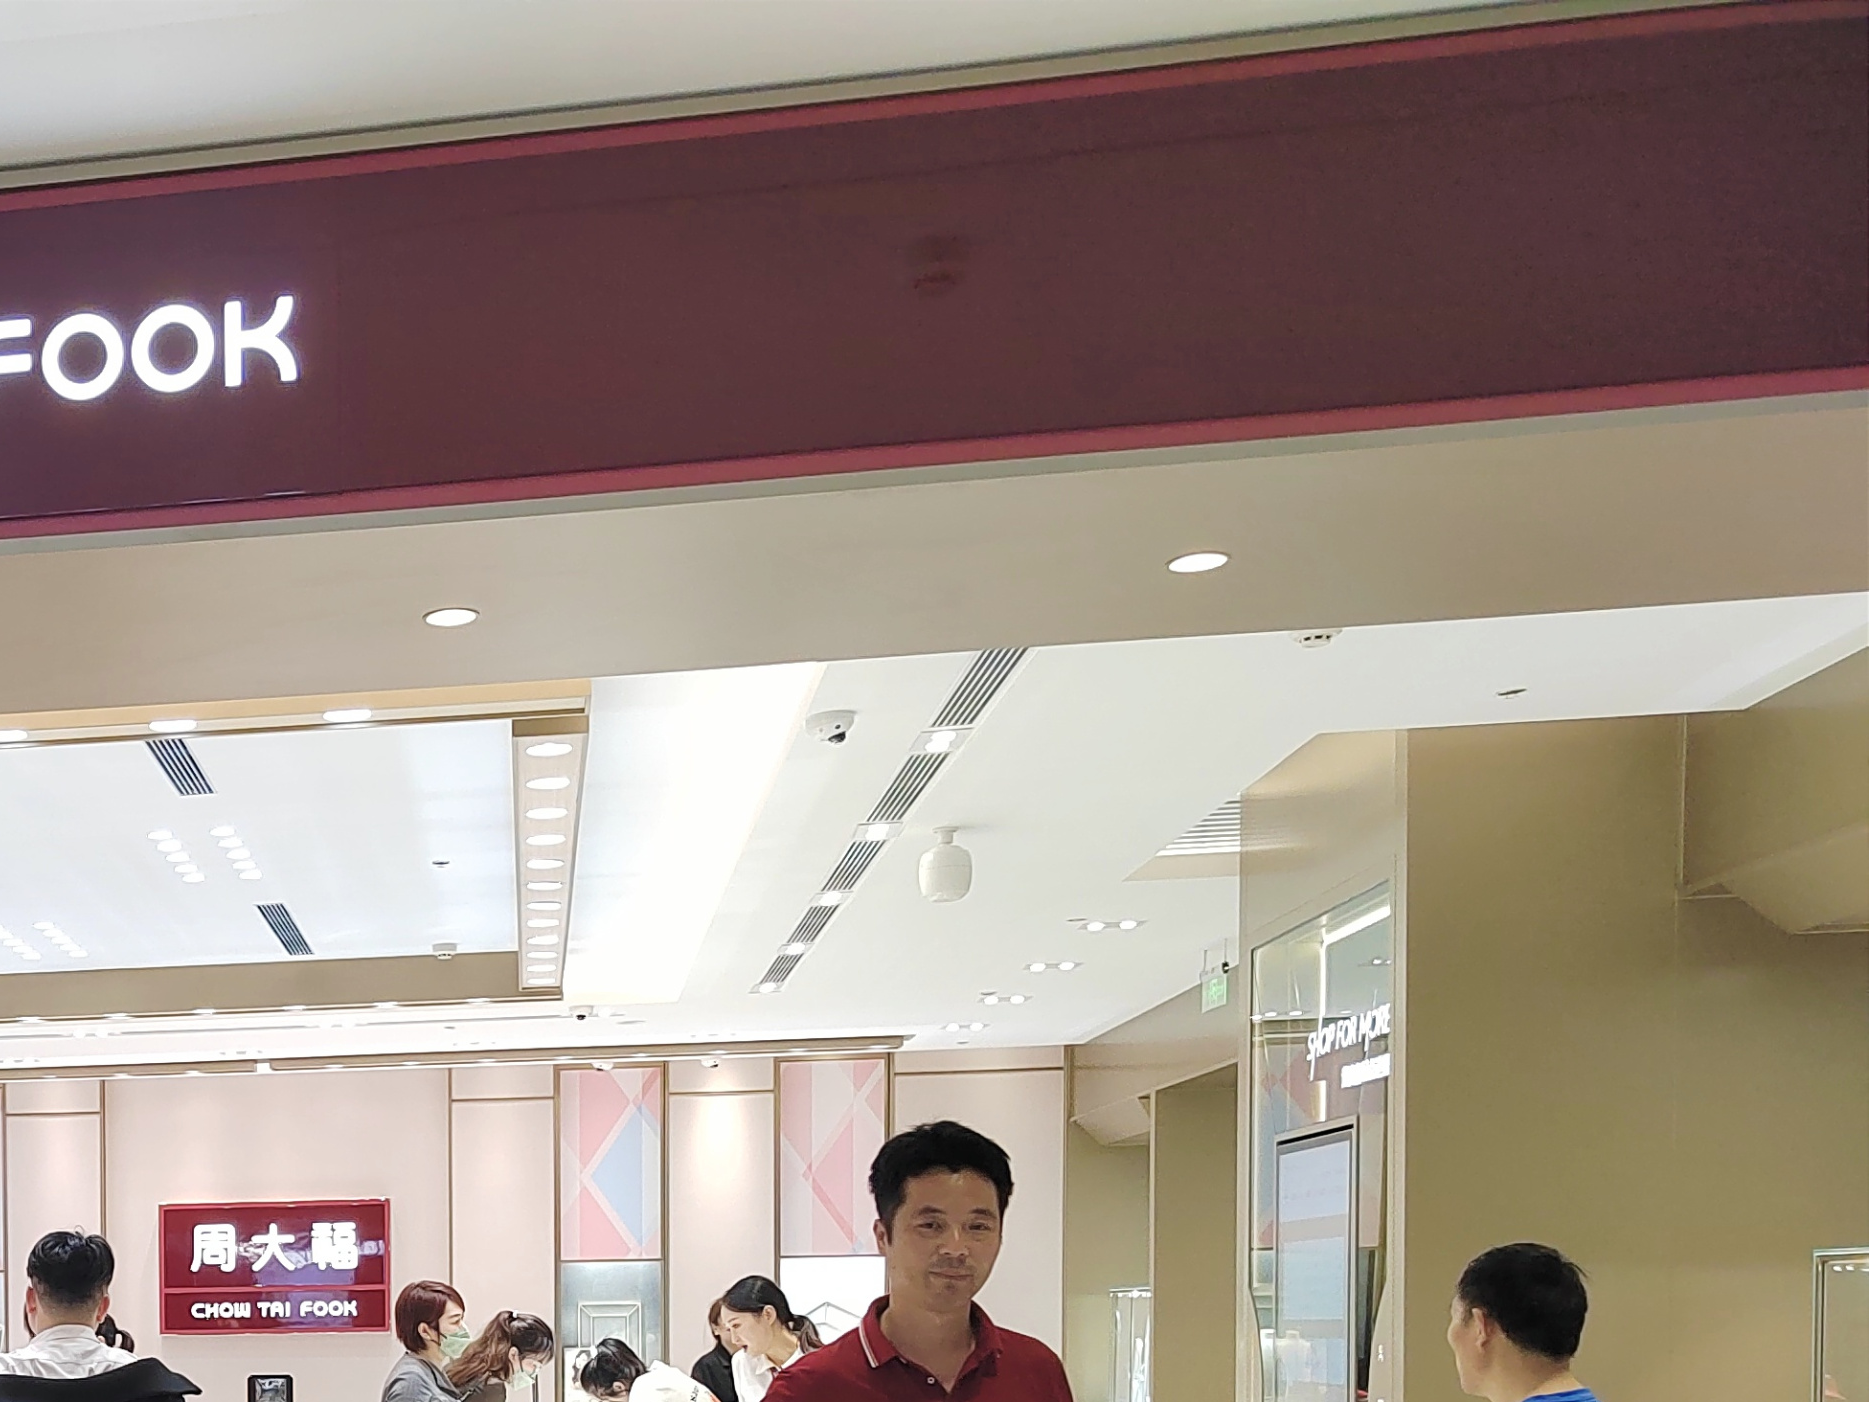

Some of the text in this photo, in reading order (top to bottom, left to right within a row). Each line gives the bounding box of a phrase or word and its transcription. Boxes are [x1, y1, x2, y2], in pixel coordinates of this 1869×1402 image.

[1334, 1015, 1357, 1050] FOR
[1358, 1003, 1390, 1050] MORE
[190, 1222, 359, 1273] 周大福
[190, 1299, 358, 1320] CHOW TAI FOOK
